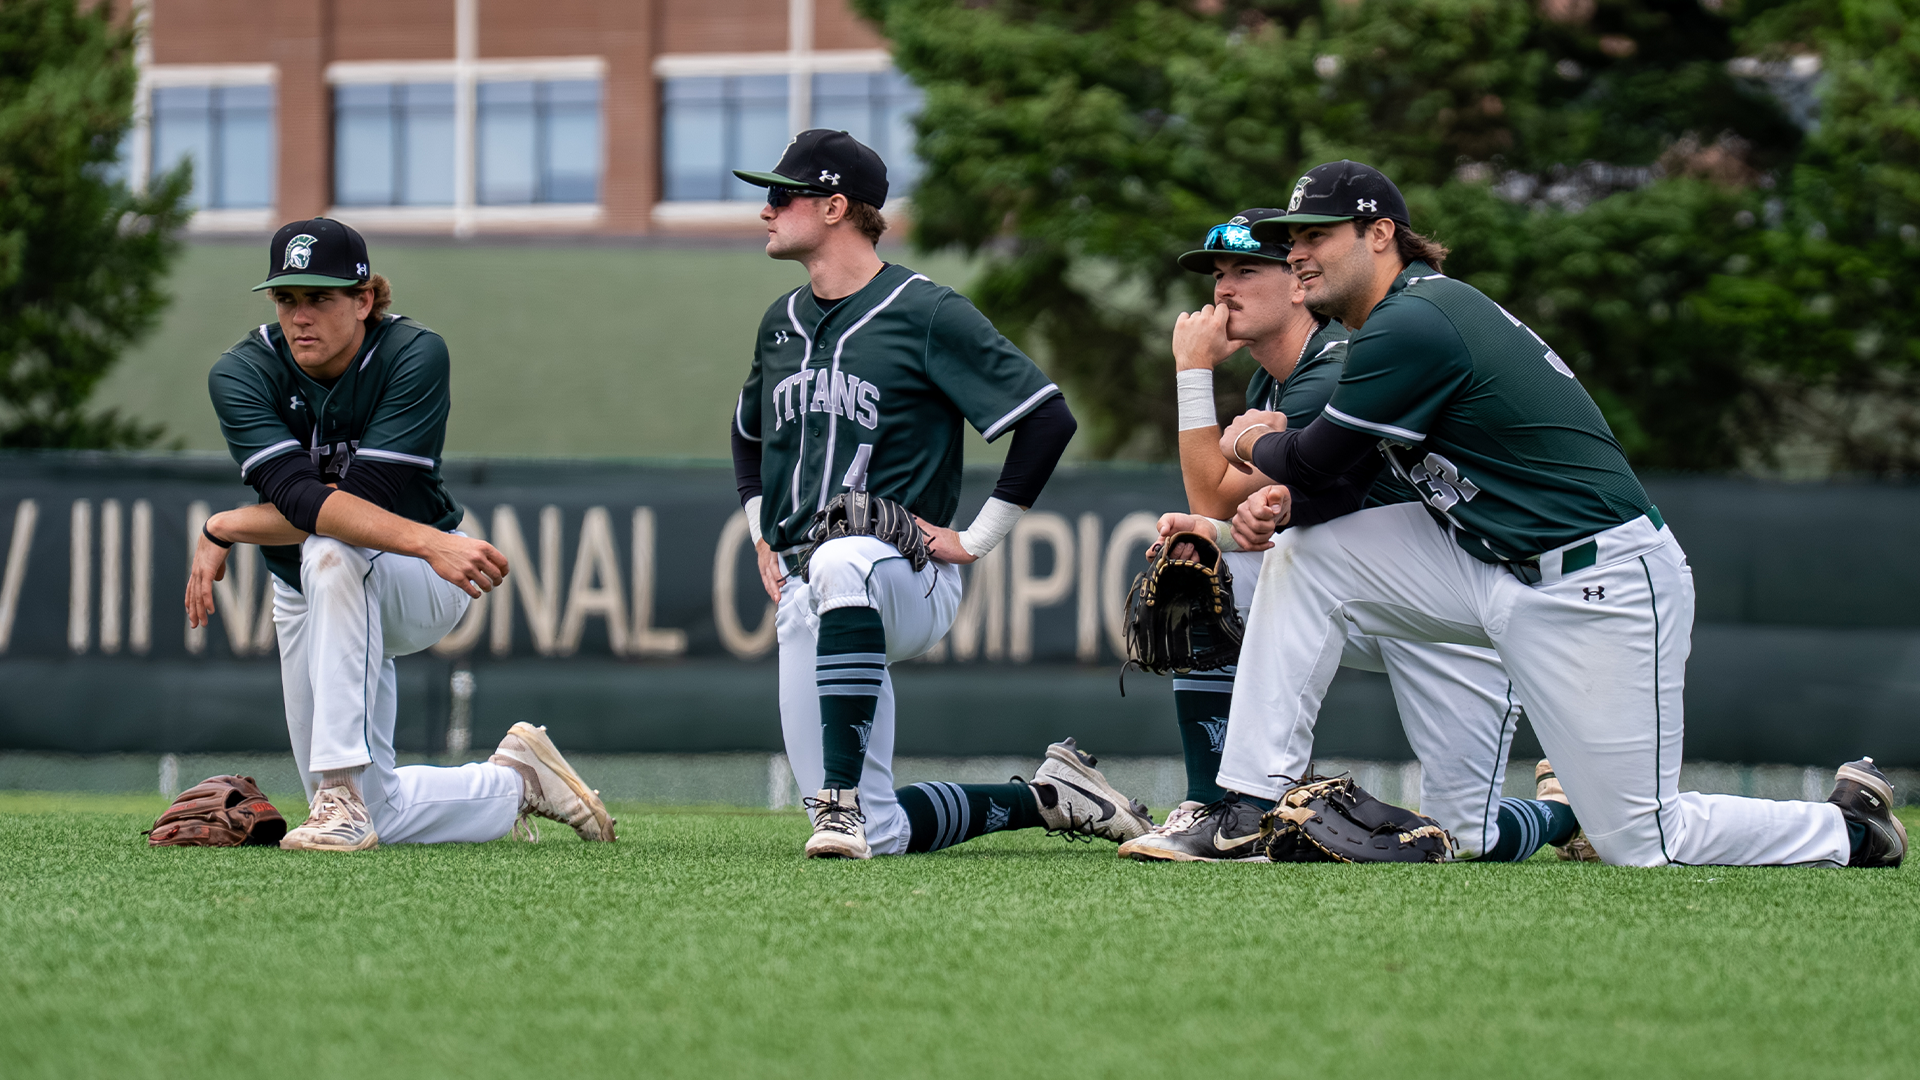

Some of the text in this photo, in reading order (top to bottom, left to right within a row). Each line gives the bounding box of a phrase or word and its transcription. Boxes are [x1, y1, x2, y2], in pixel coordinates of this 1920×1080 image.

[772, 367, 880, 432] TITANS
[841, 443, 873, 491] 4
[1409, 452, 1481, 512] 32
